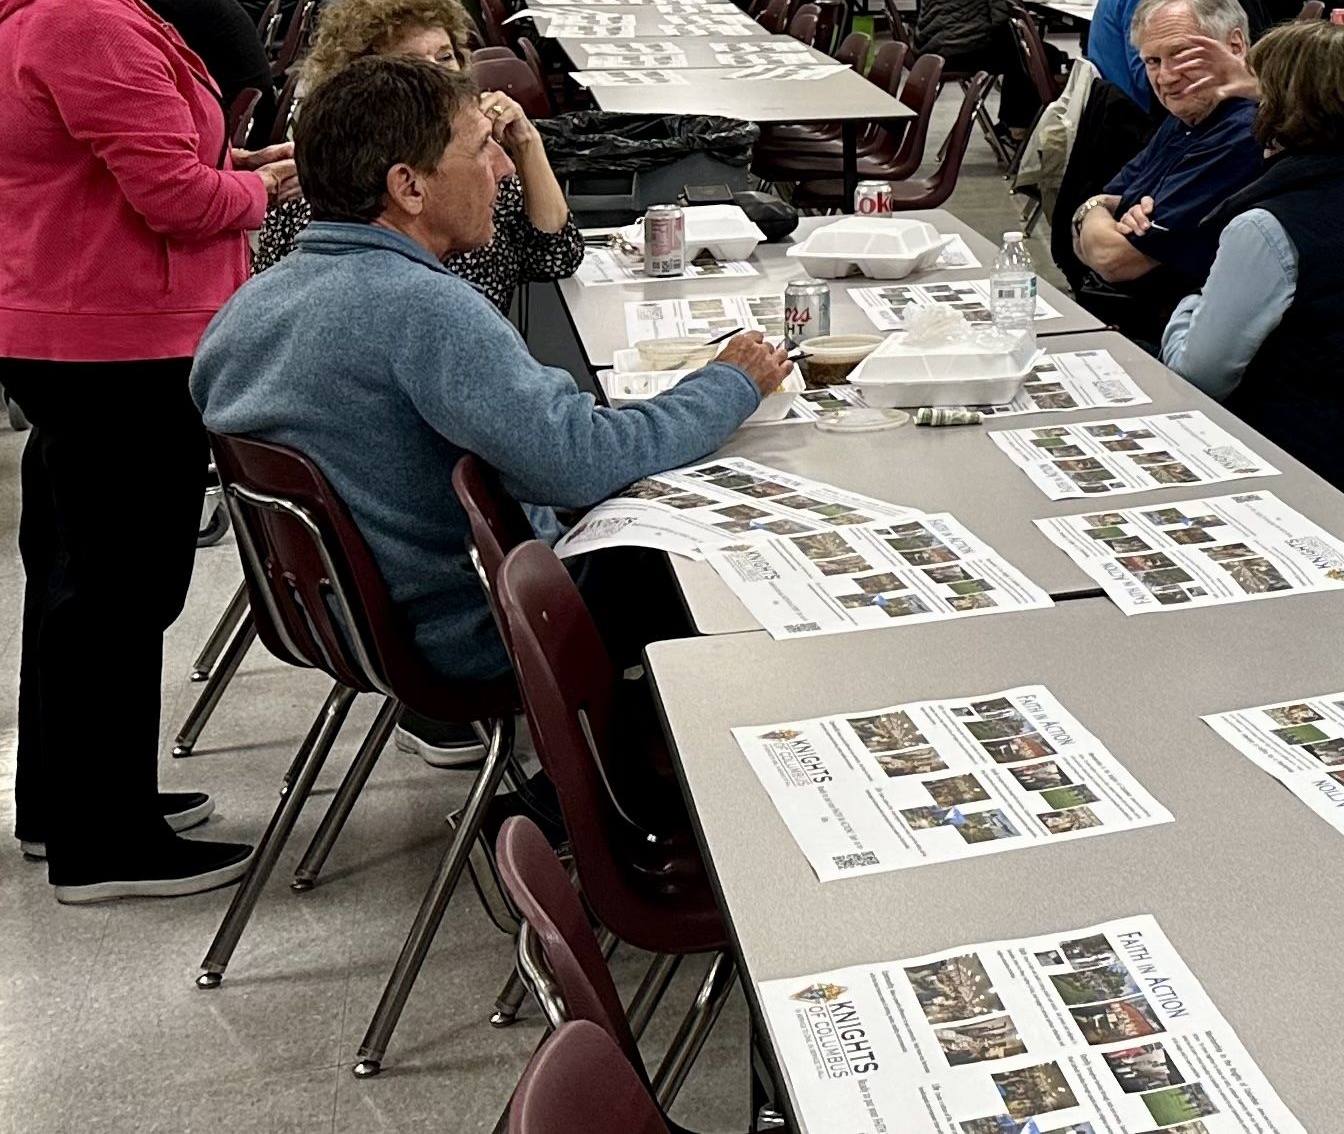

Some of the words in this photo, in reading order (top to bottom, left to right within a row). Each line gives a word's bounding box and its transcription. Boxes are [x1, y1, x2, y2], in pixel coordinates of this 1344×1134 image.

[1014, 694, 1050, 713] FAITH
[1037, 719, 1080, 745] ACTION
[787, 738, 835, 783] KNIGHTS
[1113, 930, 1159, 961] FAITH
[1135, 963, 1158, 974] IN
[806, 1004, 827, 1020] OF
[1141, 974, 1195, 1018] ACTION
[808, 1020, 854, 1078] COLUMBUS
[822, 1000, 886, 1074] KNIGHTS
